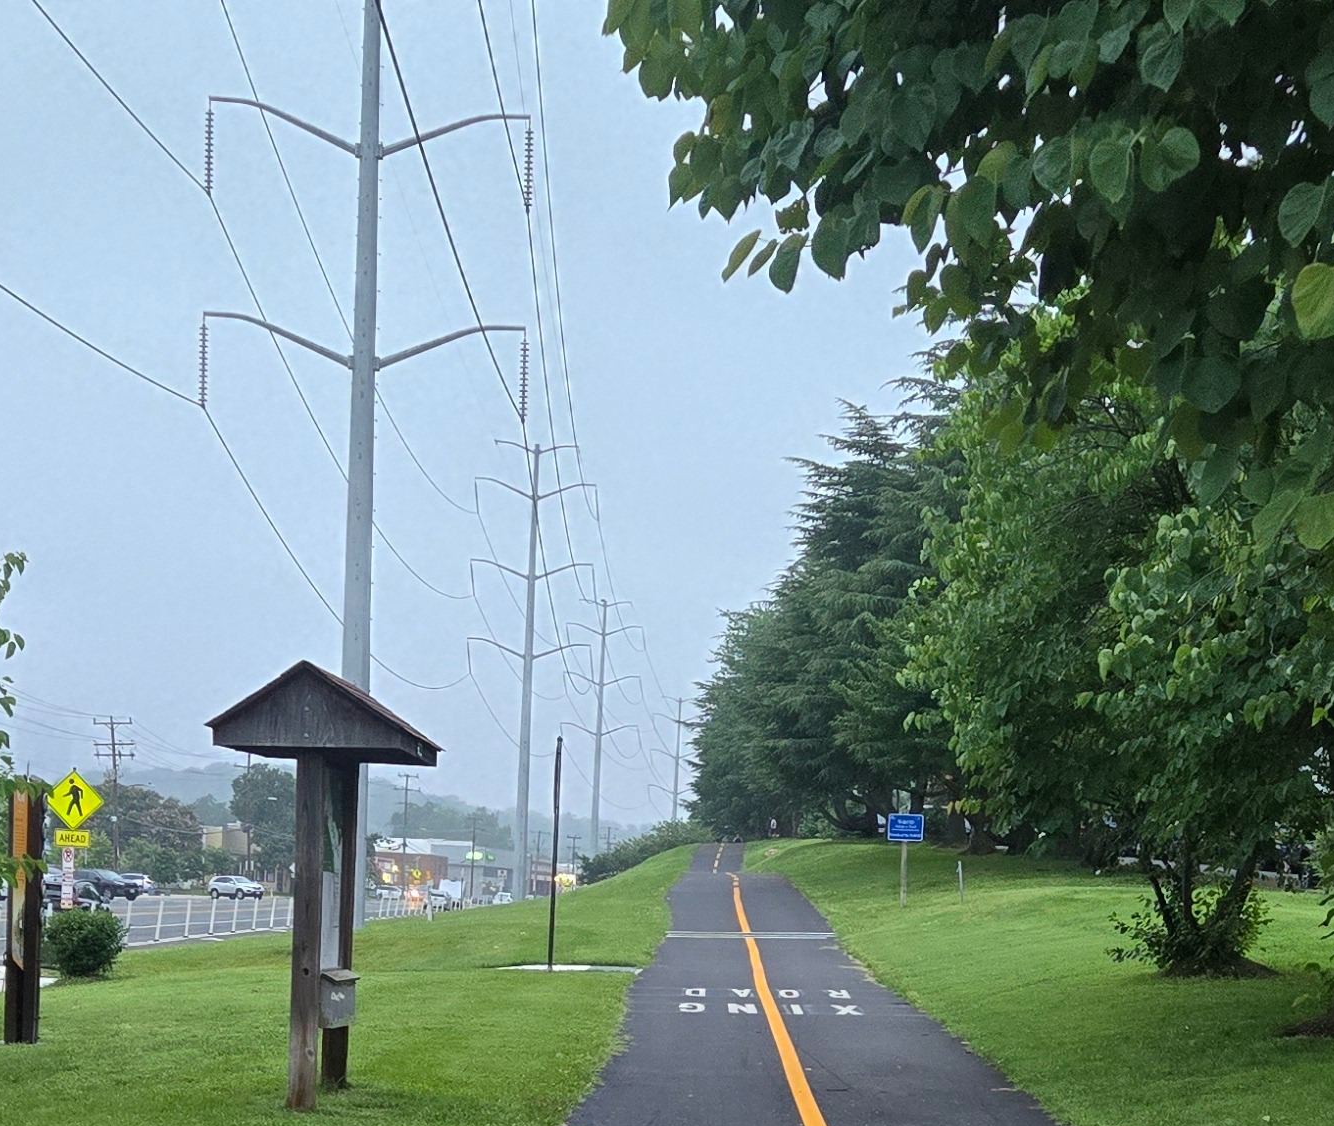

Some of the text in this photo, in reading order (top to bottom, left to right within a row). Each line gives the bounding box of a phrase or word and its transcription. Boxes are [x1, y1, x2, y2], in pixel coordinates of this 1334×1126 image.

[58, 833, 86, 843] AHEAD
[685, 988, 851, 999] ROAD
[679, 1002, 863, 1015] XING
